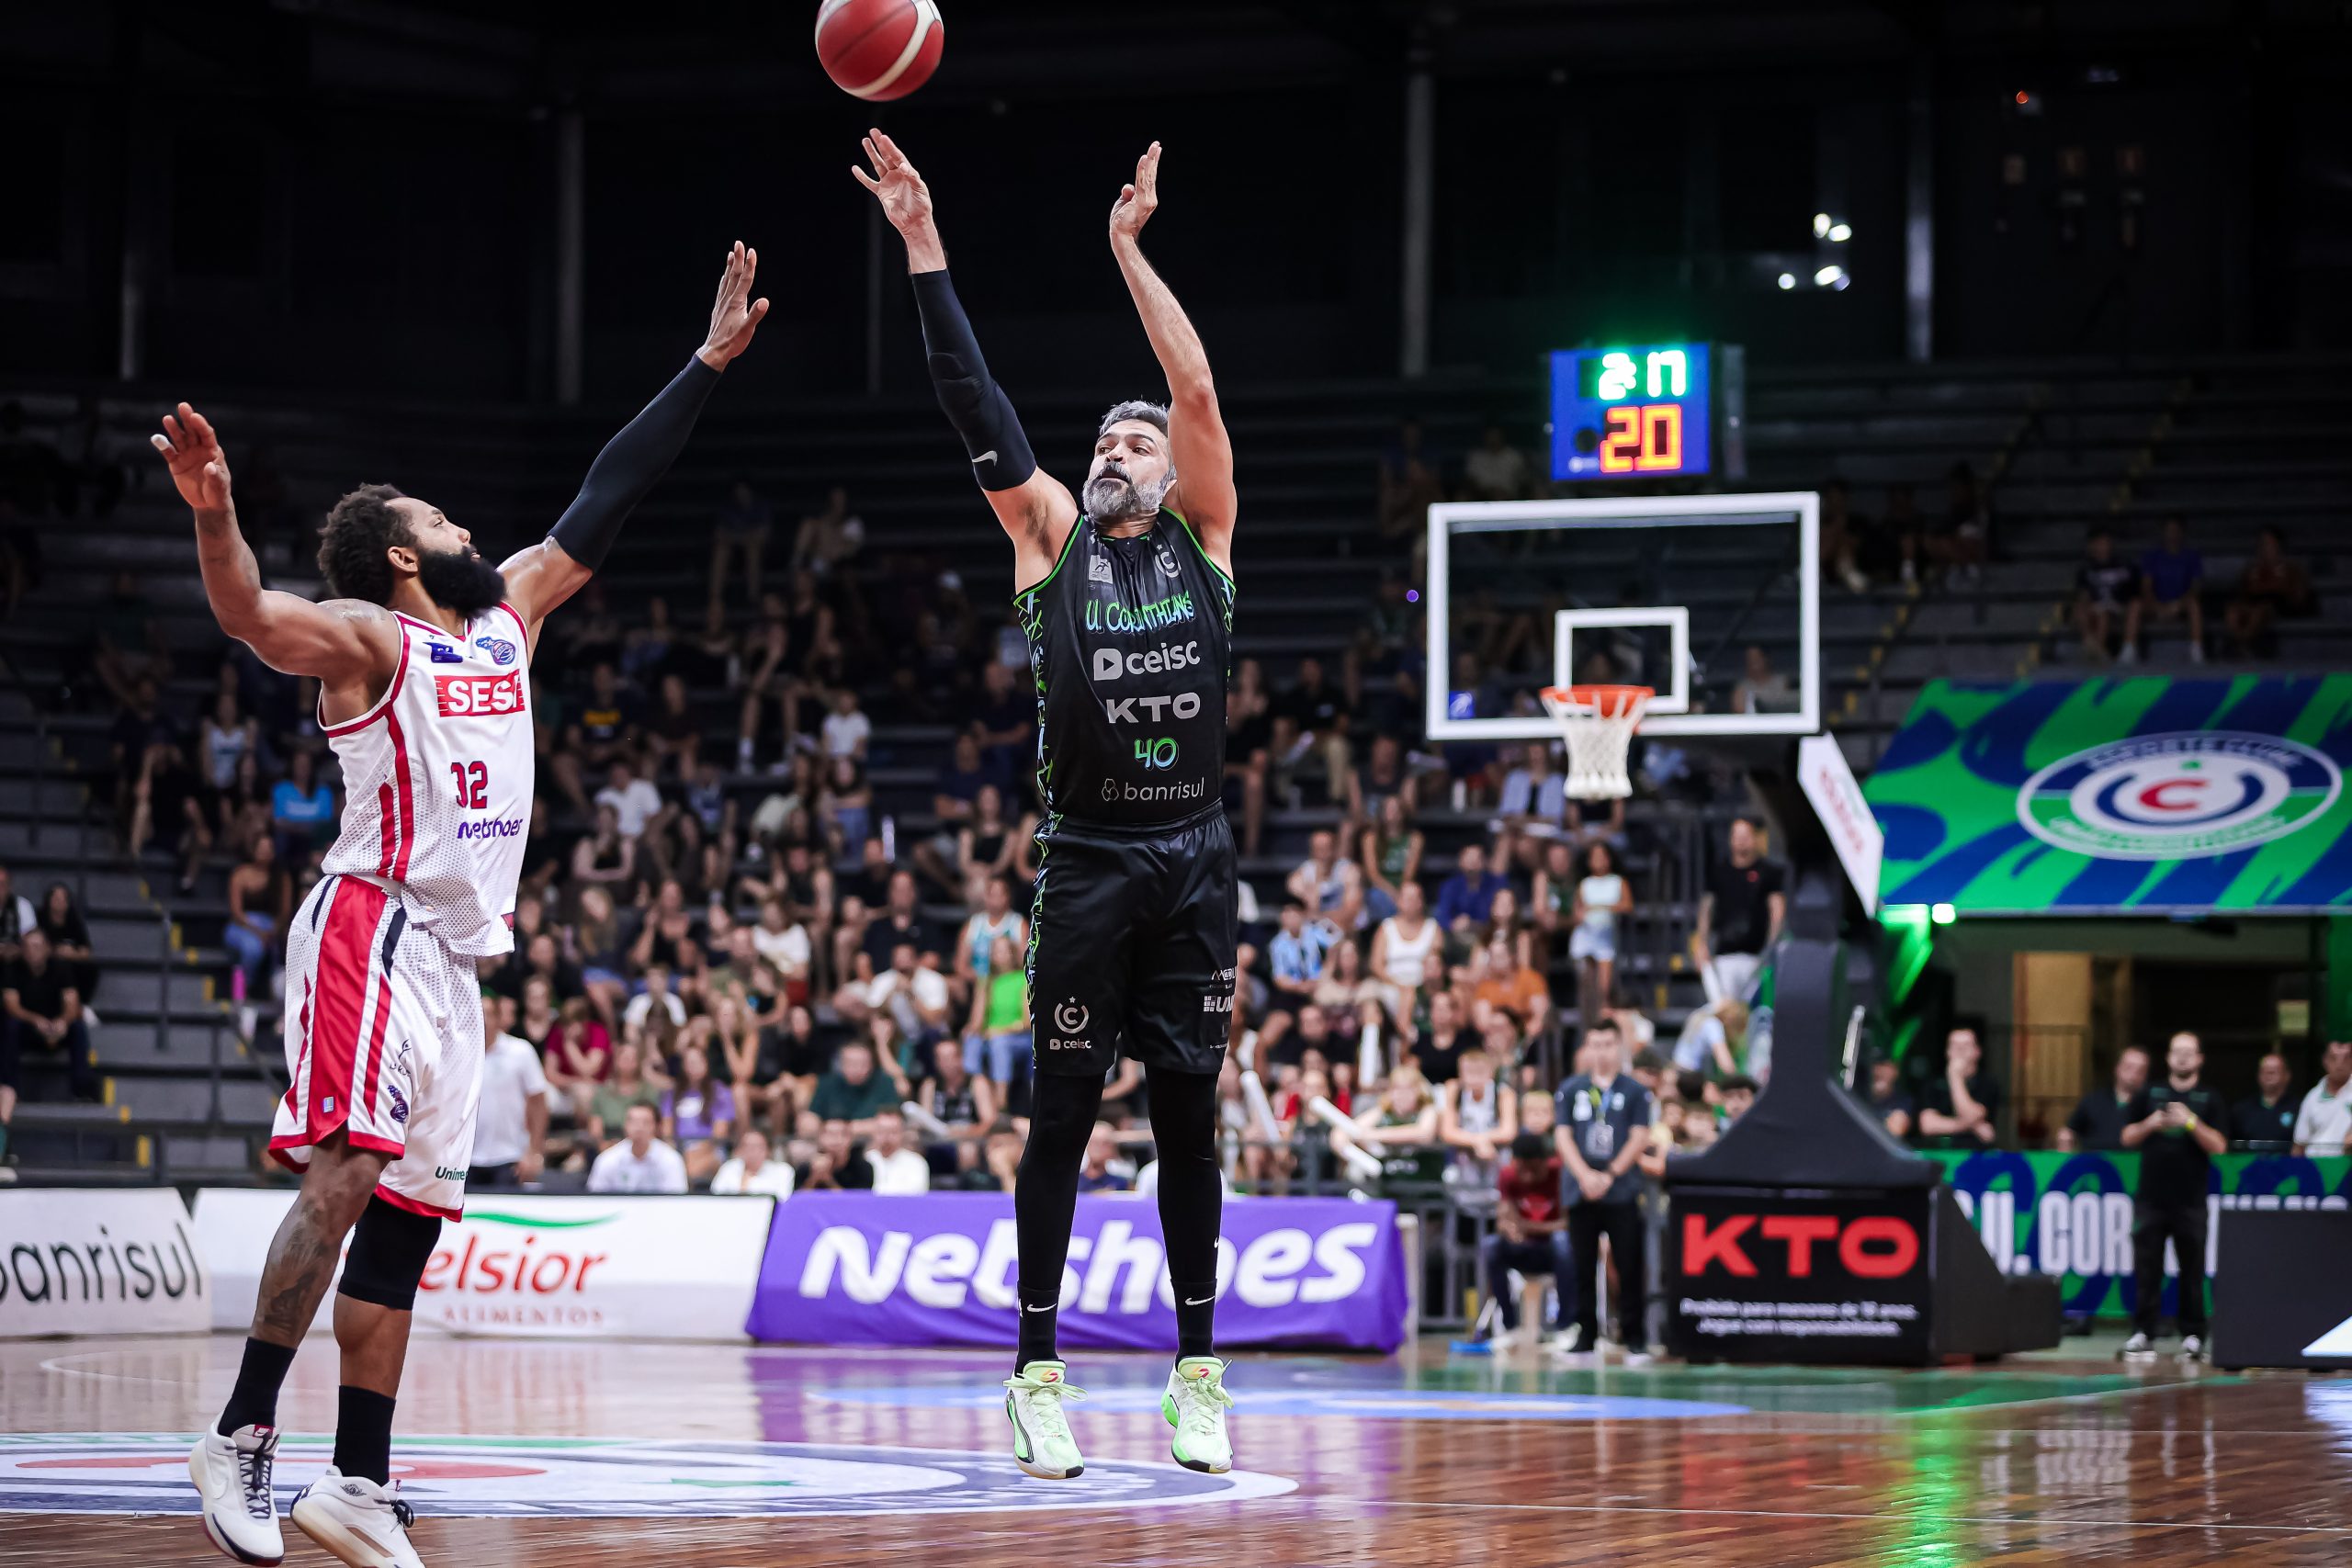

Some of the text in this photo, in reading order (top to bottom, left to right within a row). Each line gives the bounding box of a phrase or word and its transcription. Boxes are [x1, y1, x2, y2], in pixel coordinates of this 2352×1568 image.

[1600, 404, 1682, 473] 20
[1125, 640, 1201, 675] ceisc
[1106, 692, 1201, 724] KTO
[1134, 738, 1179, 770] 40
[1125, 777, 1204, 801] banrisul
[1063, 1038, 1091, 1049] ceisc
[1682, 1213, 1919, 1278] KTO
[418, 1234, 608, 1293] elsior
